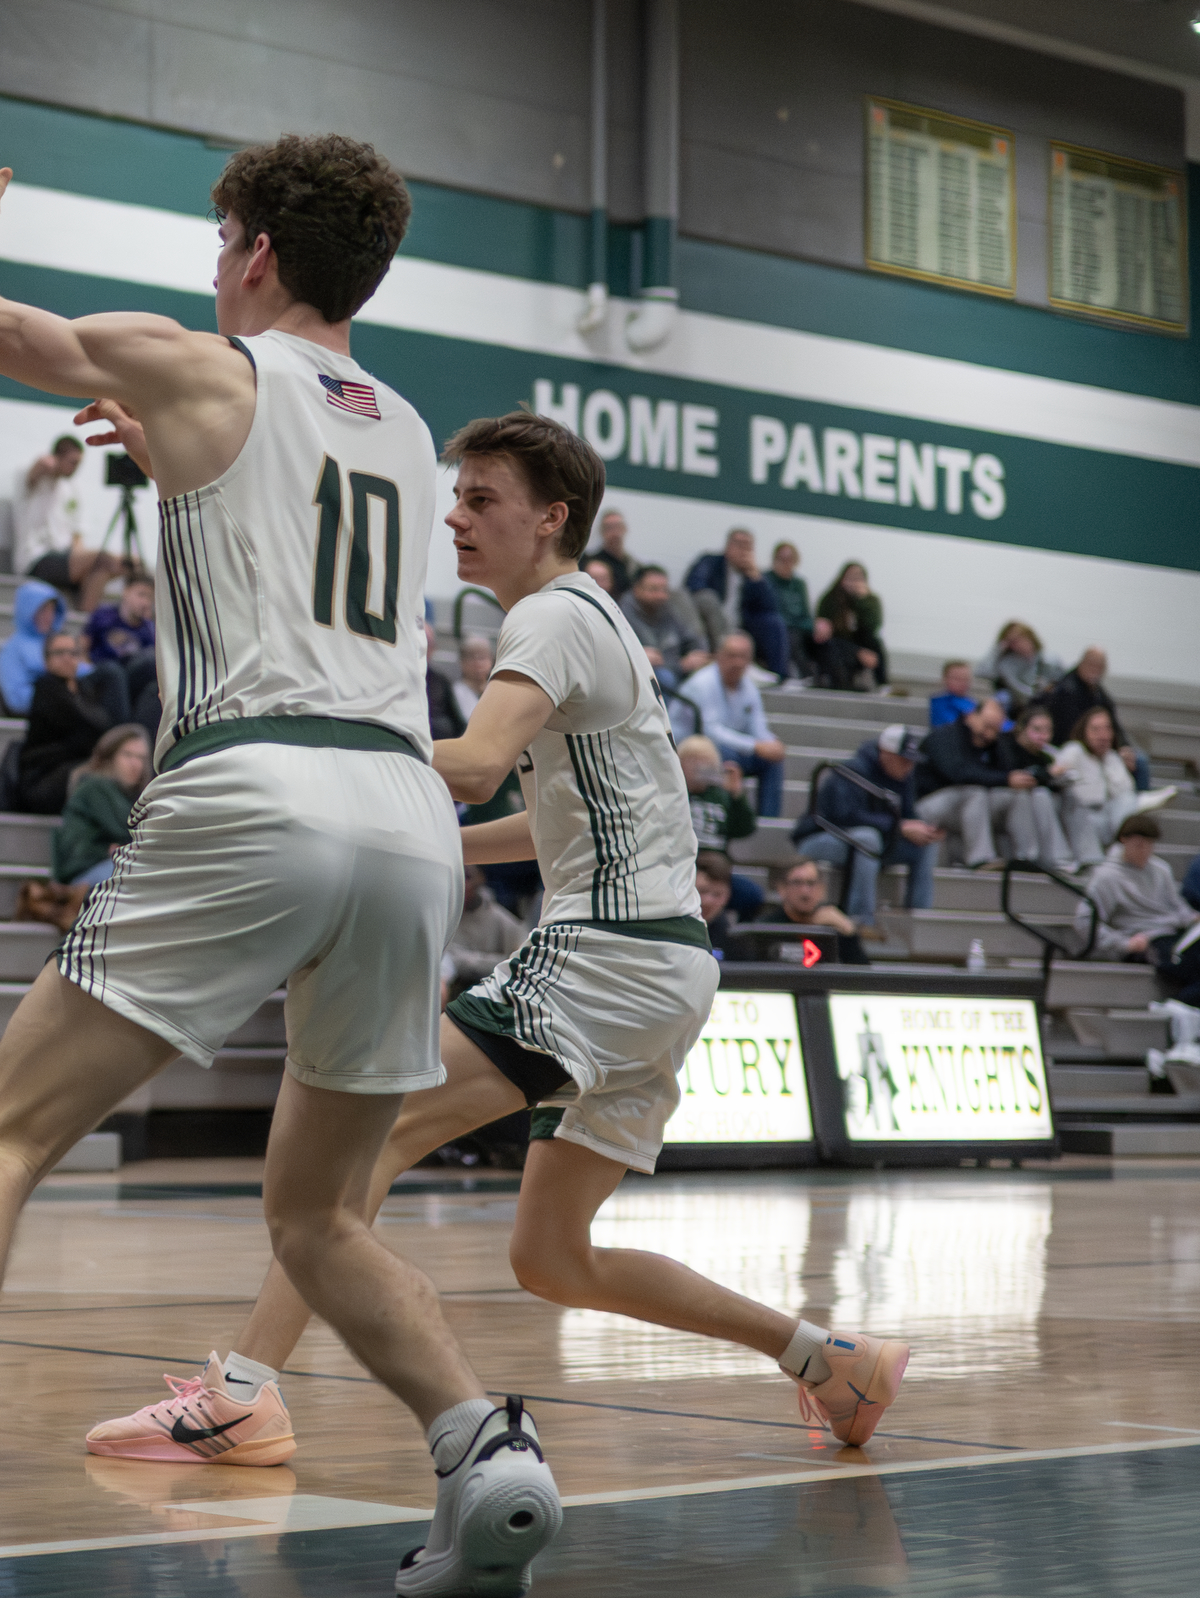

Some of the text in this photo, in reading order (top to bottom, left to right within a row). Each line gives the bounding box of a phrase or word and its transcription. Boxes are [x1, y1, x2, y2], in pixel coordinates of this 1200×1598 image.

[533, 378, 1006, 521] HOME PARENTS
[311, 451, 401, 648] 10
[729, 998, 760, 1024] TO
[902, 1010, 1027, 1031] HOME OF THE
[685, 1037, 793, 1097] TURY
[901, 1044, 1043, 1117] KNIGHTS
[684, 1110, 780, 1138] SCHOOL
